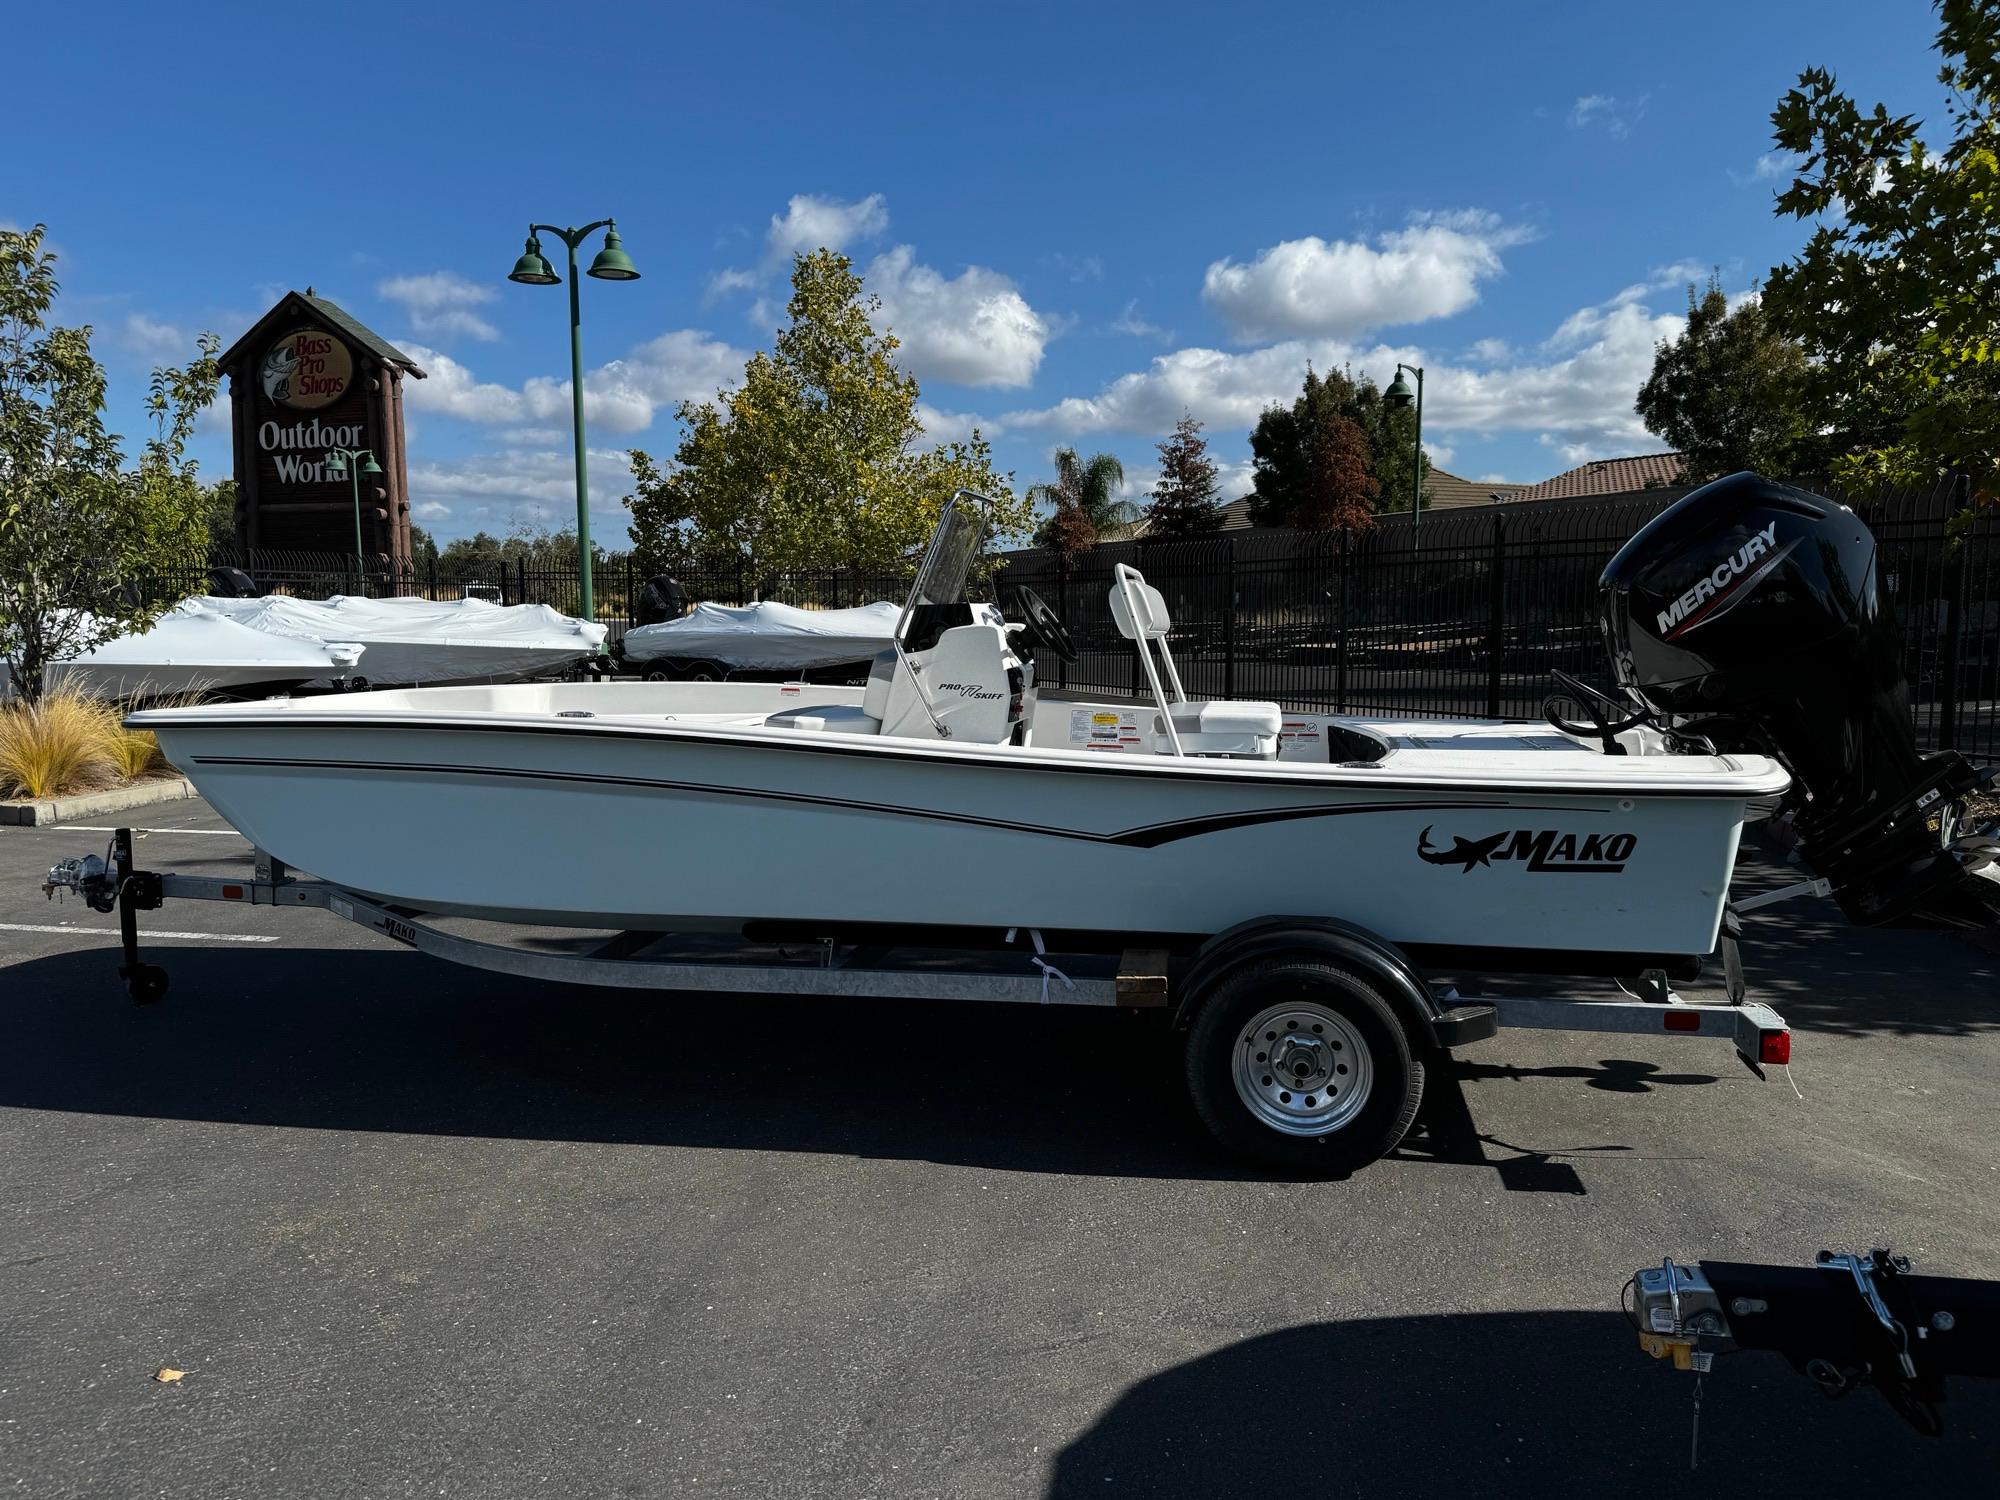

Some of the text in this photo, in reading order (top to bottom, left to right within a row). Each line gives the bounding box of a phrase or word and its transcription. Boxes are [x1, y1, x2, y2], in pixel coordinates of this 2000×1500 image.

[296, 335, 332, 356] Bass
[298, 356, 325, 376] Pro
[299, 375, 344, 398] Shops
[259, 418, 364, 450] Outdoor
[1656, 520, 1777, 635] MERCURY
[974, 692, 1005, 700] SKIFF
[1490, 830, 1638, 873] MAKO
[374, 917, 418, 948] MAKO
